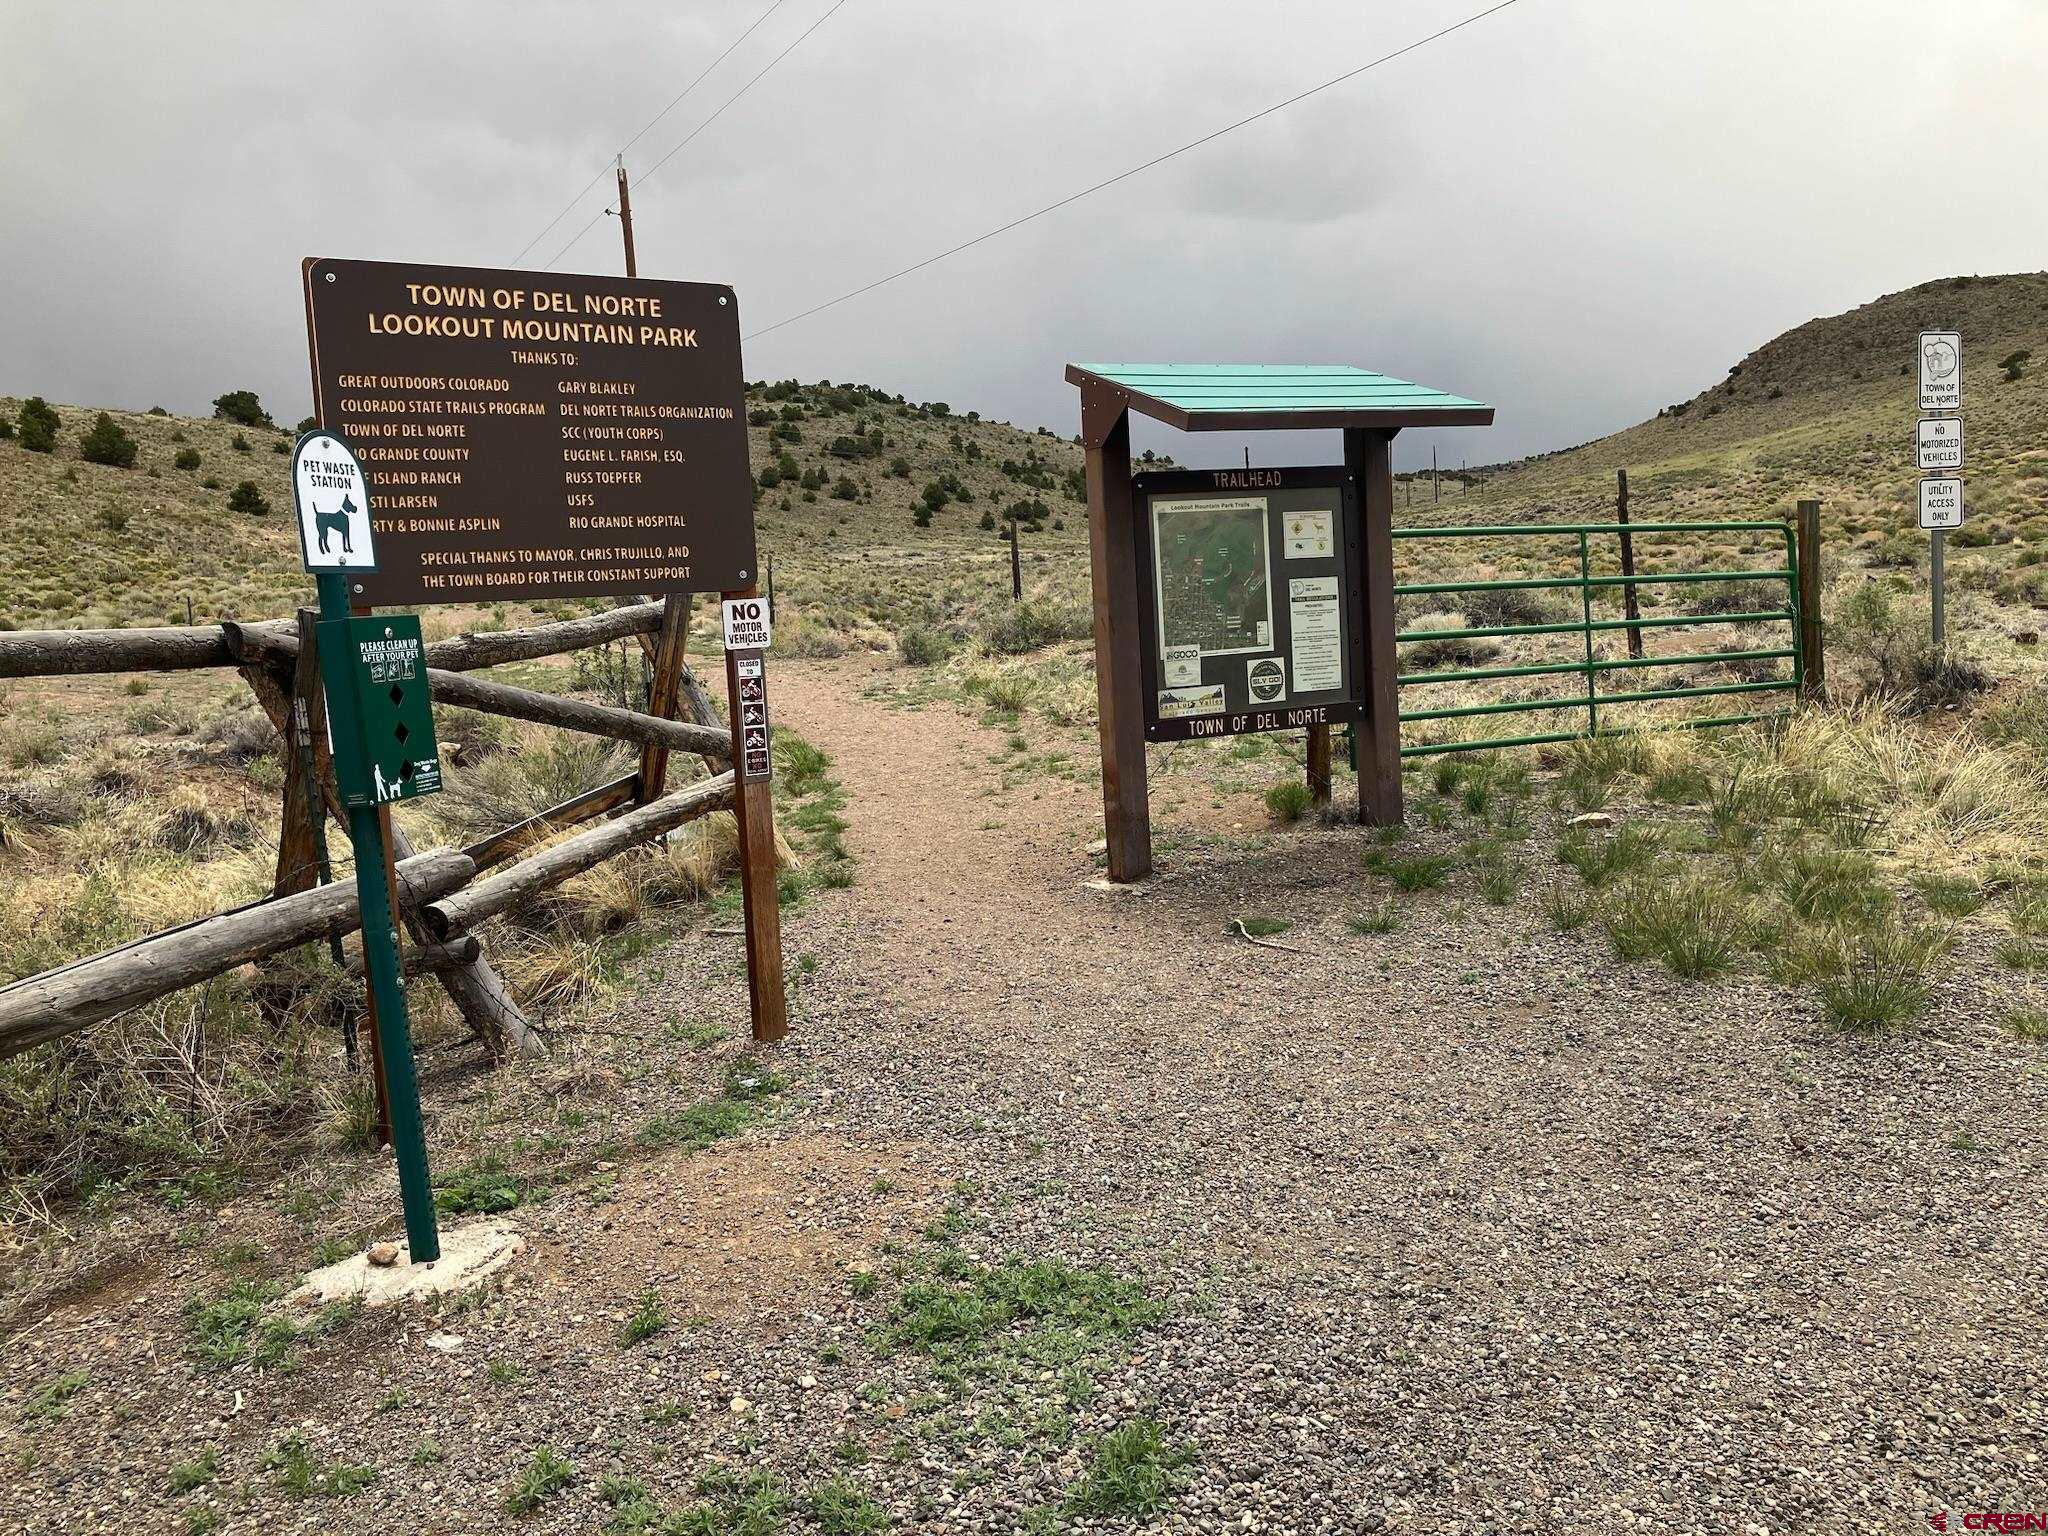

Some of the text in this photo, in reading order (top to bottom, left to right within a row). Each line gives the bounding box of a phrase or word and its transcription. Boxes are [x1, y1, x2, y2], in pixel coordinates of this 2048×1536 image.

[406, 284, 662, 317] TOWN OF DEL NORTE
[368, 313, 698, 347] LOOKOUT MOUNTAIN PARK
[511, 350, 579, 366] THANKS TO:
[338, 375, 509, 391] GREAT OUTDOORS COLORADO
[558, 381, 635, 395] GARY BLAKLEY
[1925, 383, 1955, 392] TOWN OF
[1921, 395, 1958, 403] DEL NORTE
[340, 399, 545, 415] COLORADO STATE TRAILS PROGRAM
[560, 403, 734, 419] DEL NORTE TRAILS ORGANIZATION
[343, 424, 466, 438] TOWN OF DEL NORTE
[561, 427, 664, 441] SCC (YOUTH CORPS)
[1935, 426, 1945, 435] NO
[1921, 439, 1959, 448] MOTORIZED
[370, 448, 419, 461] GRANDE
[423, 448, 470, 461] COUNTY
[563, 449, 686, 463] EUGENE L. FARISH, ESQ.
[1923, 452, 1958, 461] VEHICLES
[303, 460, 320, 473] PET
[322, 462, 355, 476] WASTE
[311, 476, 352, 489] STATION
[373, 471, 418, 484] ISLAND
[420, 472, 462, 484] RANCH
[566, 472, 642, 484] RUSS TOEPFER
[1213, 471, 1281, 487] TRAILHEAD
[1928, 486, 1953, 495] UTILITY
[392, 496, 438, 508] LARSEN
[567, 494, 594, 506] USFS
[1928, 499, 1954, 508] ACCESS
[569, 515, 686, 529] RIO GRANDE HOSPITAL
[1932, 512, 1949, 520] ONLY
[398, 520, 407, 532] &
[410, 519, 455, 532] BONNIE
[459, 518, 500, 531] ASPLIN
[420, 546, 690, 565] SPECIAL THANKS TO MAYOR, CHRIS TRUJILLO, AND
[422, 566, 691, 588] THE TOWN BOARD FOR THEIR CONSTANT SUPPORT
[732, 604, 761, 621] NO
[732, 622, 762, 634] MOTOR
[360, 638, 417, 652] PLEASE CLEAN UP
[729, 632, 768, 644] VEHICLES
[363, 650, 418, 662] AFTER YOUR PET
[1189, 708, 1326, 735] TOWN OF DEL NORTE
